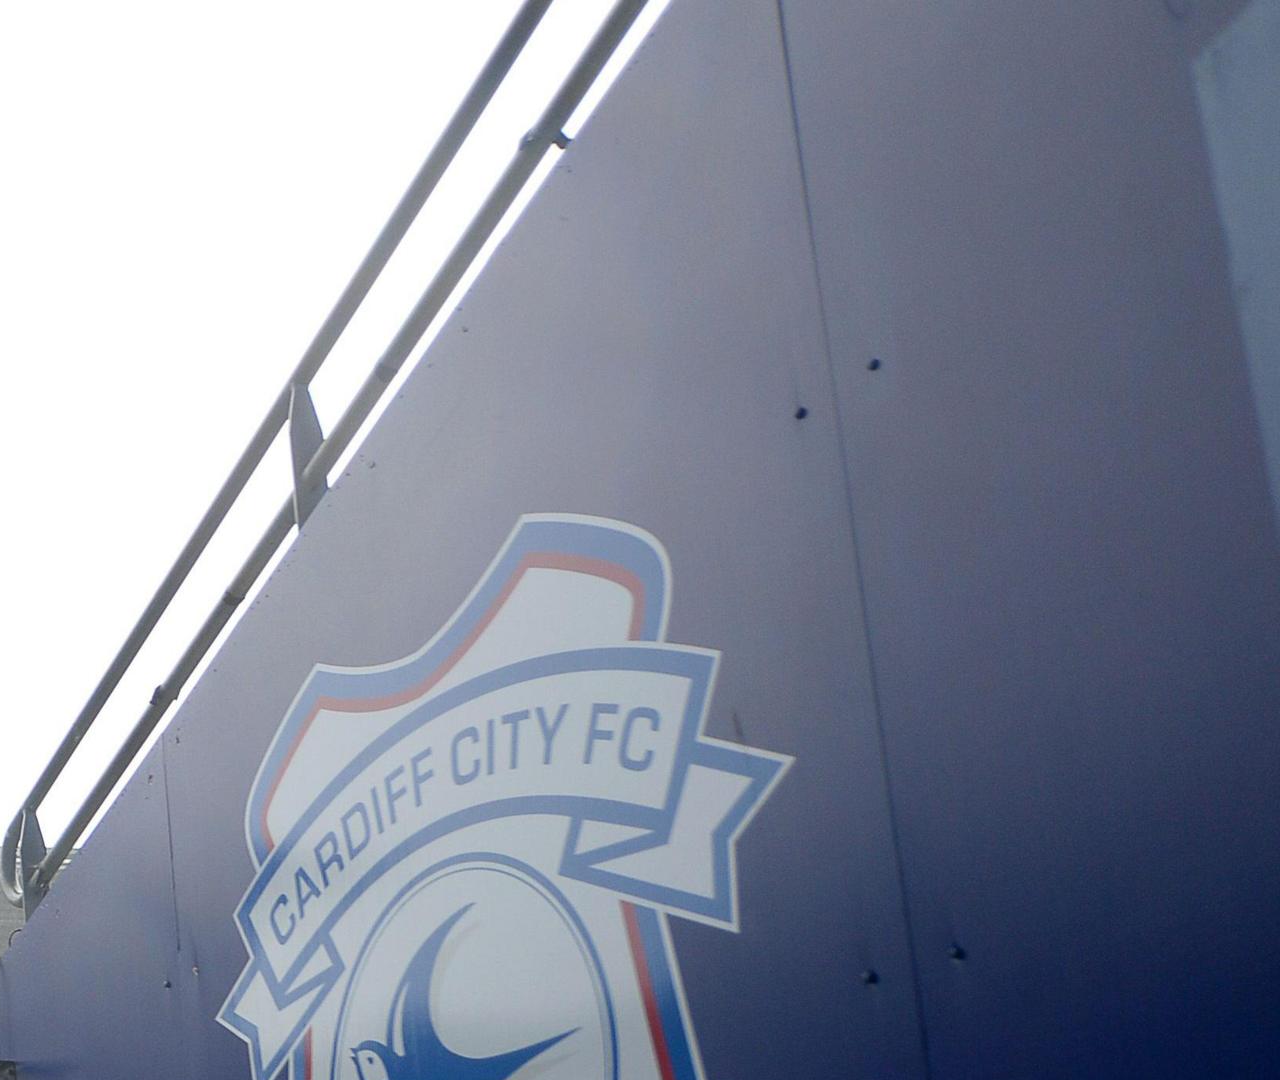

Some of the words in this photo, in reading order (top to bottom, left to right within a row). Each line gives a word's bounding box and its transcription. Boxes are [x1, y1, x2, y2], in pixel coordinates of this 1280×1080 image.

[268, 747, 435, 946] CARDIFF
[449, 702, 570, 787] CITY
[582, 702, 662, 772] FC
